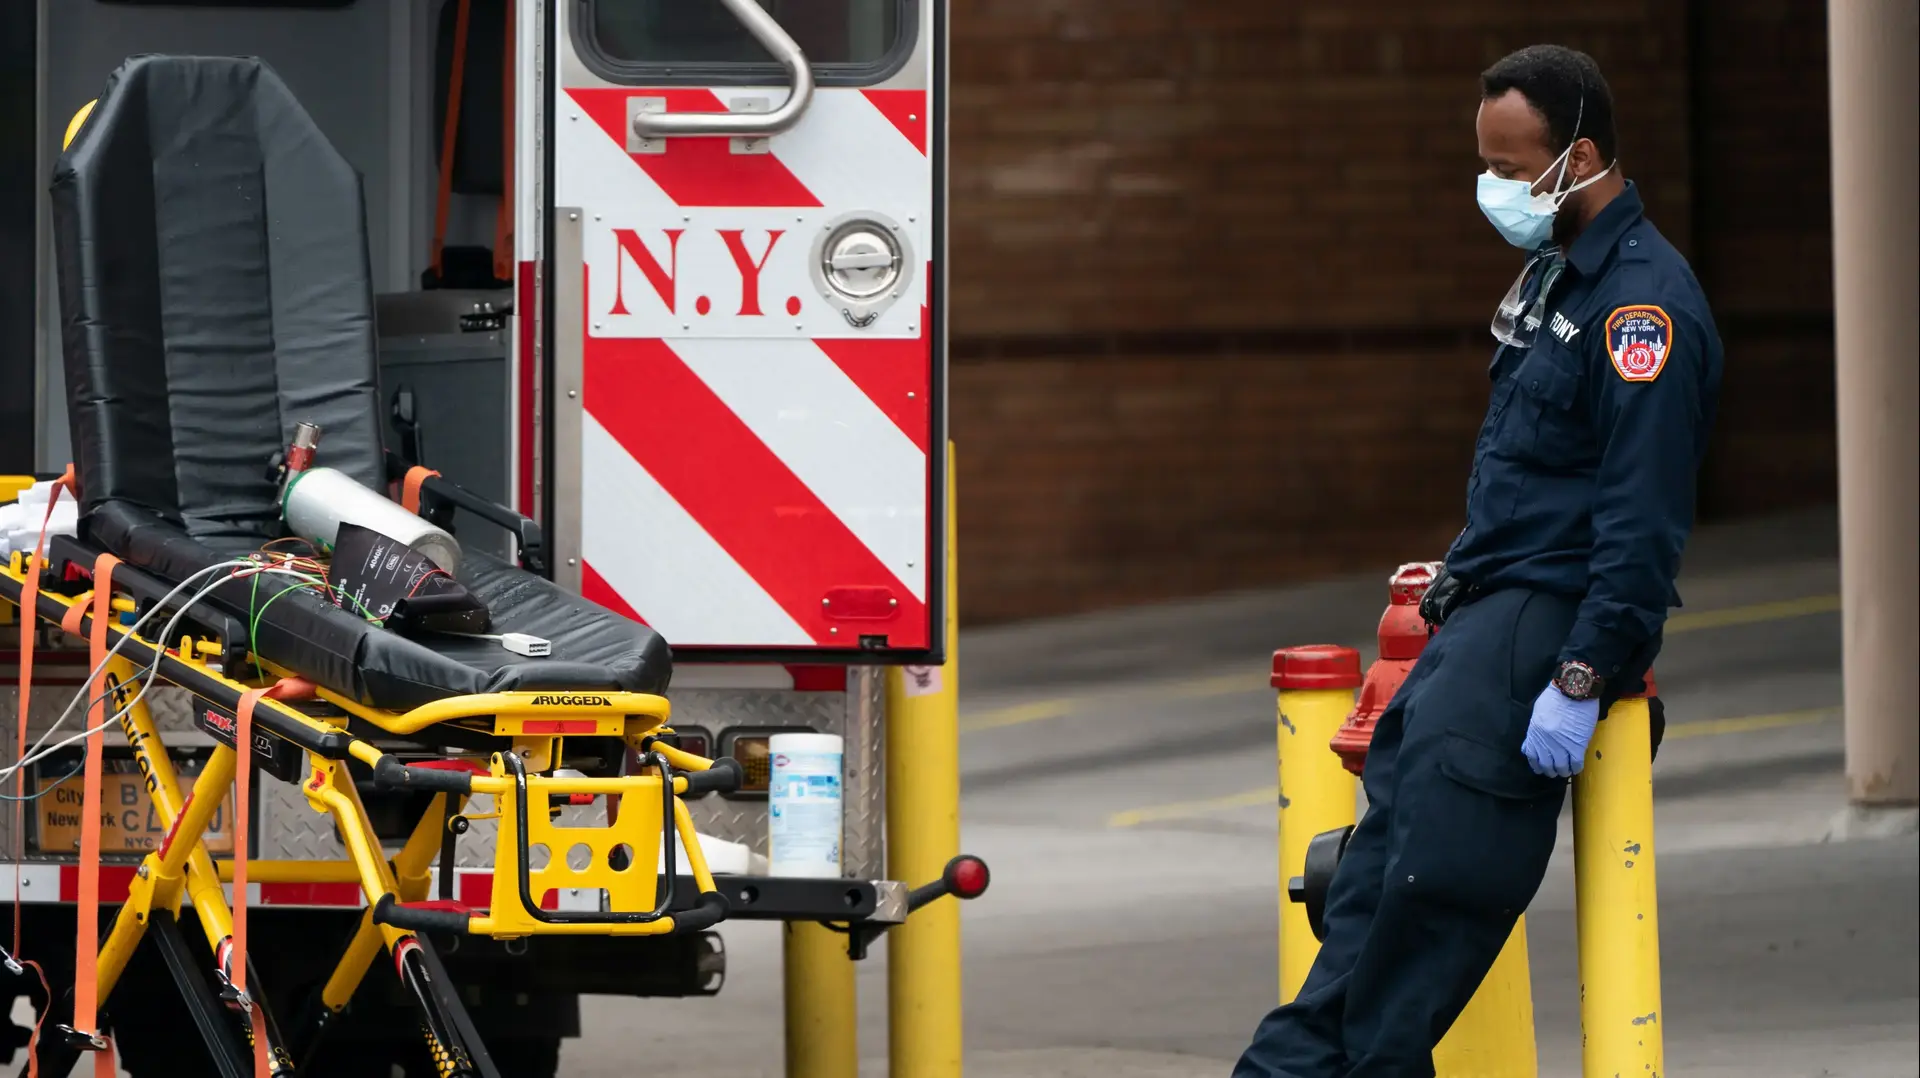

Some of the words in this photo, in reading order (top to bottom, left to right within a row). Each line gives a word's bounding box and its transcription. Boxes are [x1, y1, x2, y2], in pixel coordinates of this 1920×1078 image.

[608, 229, 802, 316] N.Y.
[1549, 311, 1580, 343] FDNY
[1611, 316, 1626, 331] FIRE
[1624, 311, 1666, 328] DEPARTMENT
[1626, 319, 1641, 327] CITY
[1642, 319, 1651, 327] OF
[540, 695, 602, 706] RUGGED
[56, 787, 84, 806] City
[47, 811, 79, 826] New
[124, 837, 154, 848] NYC
